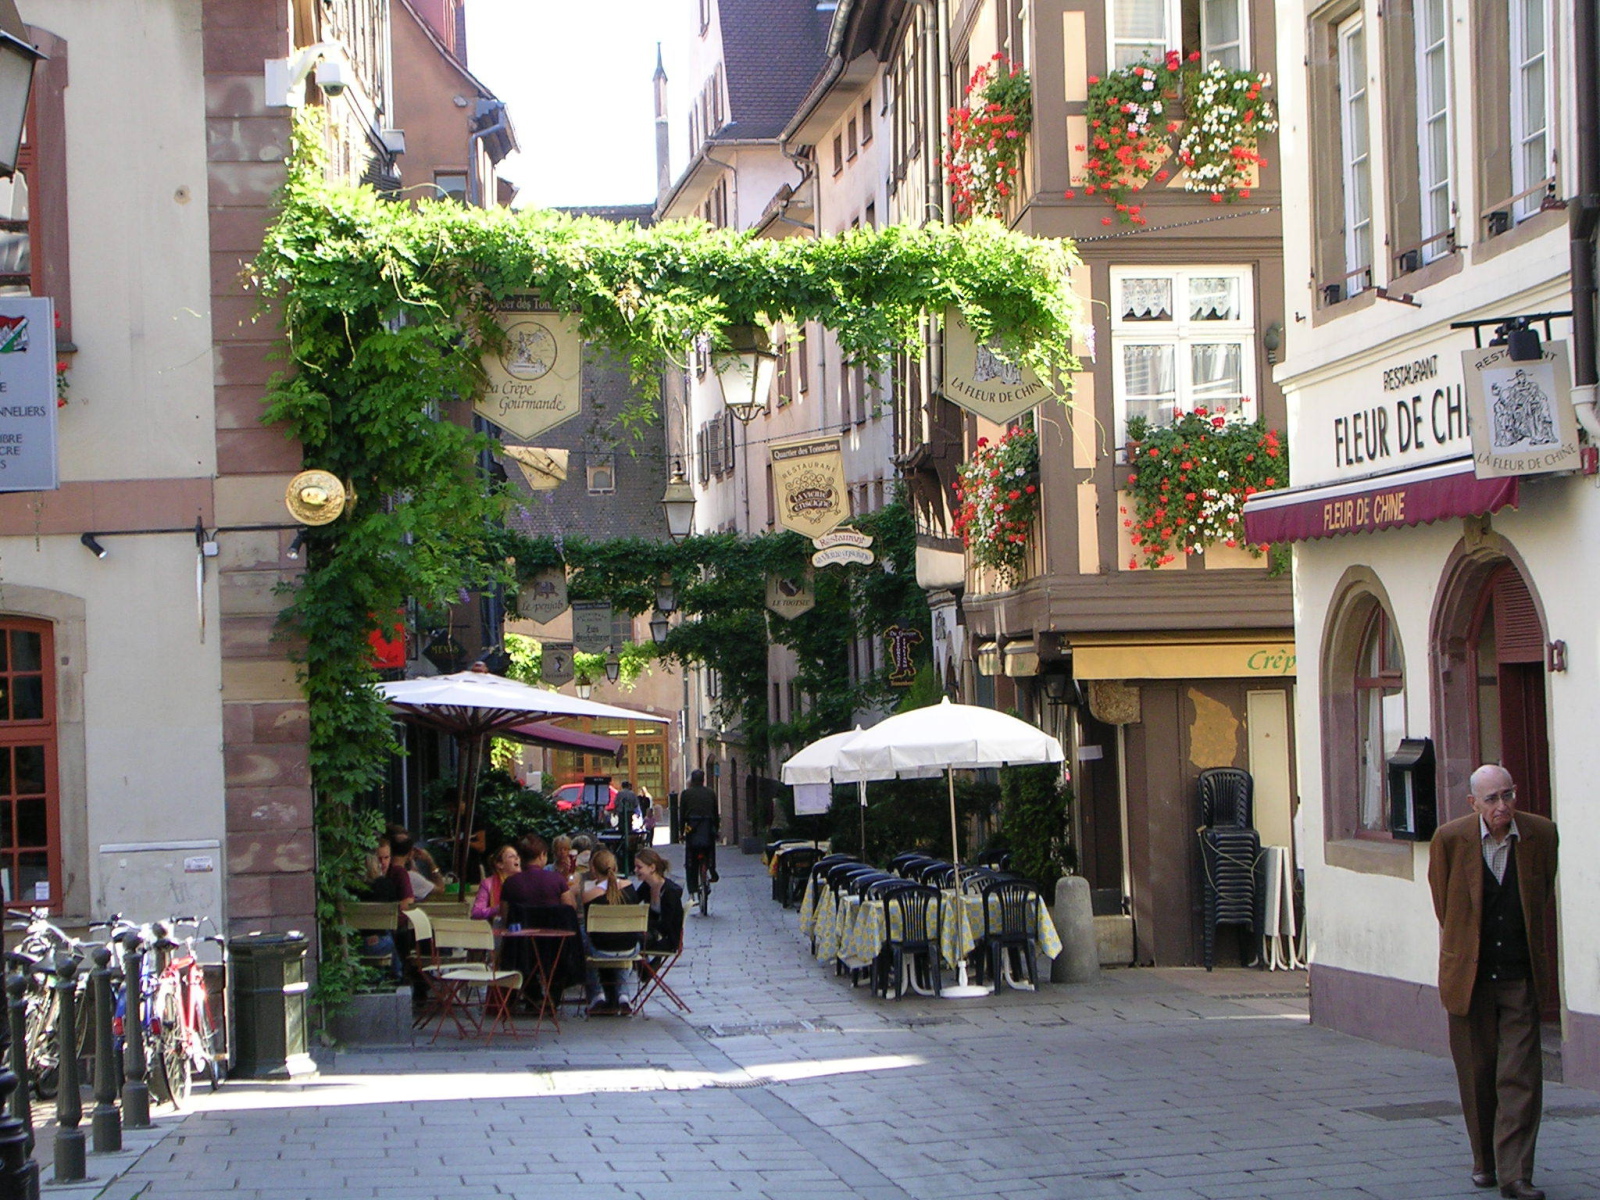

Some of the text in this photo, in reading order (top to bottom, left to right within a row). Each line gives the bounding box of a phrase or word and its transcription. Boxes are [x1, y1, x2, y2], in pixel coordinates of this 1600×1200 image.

[1383, 354, 1438, 392] RESTAURANT
[502, 380, 536, 399] Crêpe
[951, 377, 1042, 403] LA FLEUR DE CHIN
[499, 394, 566, 416] Gourmande
[1335, 384, 1471, 467] FLEUR DE CHI
[774, 449, 797, 460] Quartier
[798, 447, 808, 455] des
[1477, 442, 1577, 471] LA FLEUR DE CHINE
[781, 462, 836, 479] RESTAURANT
[1324, 491, 1405, 531] FLEUR DE CHINE
[1247, 649, 1297, 674] Crêp
